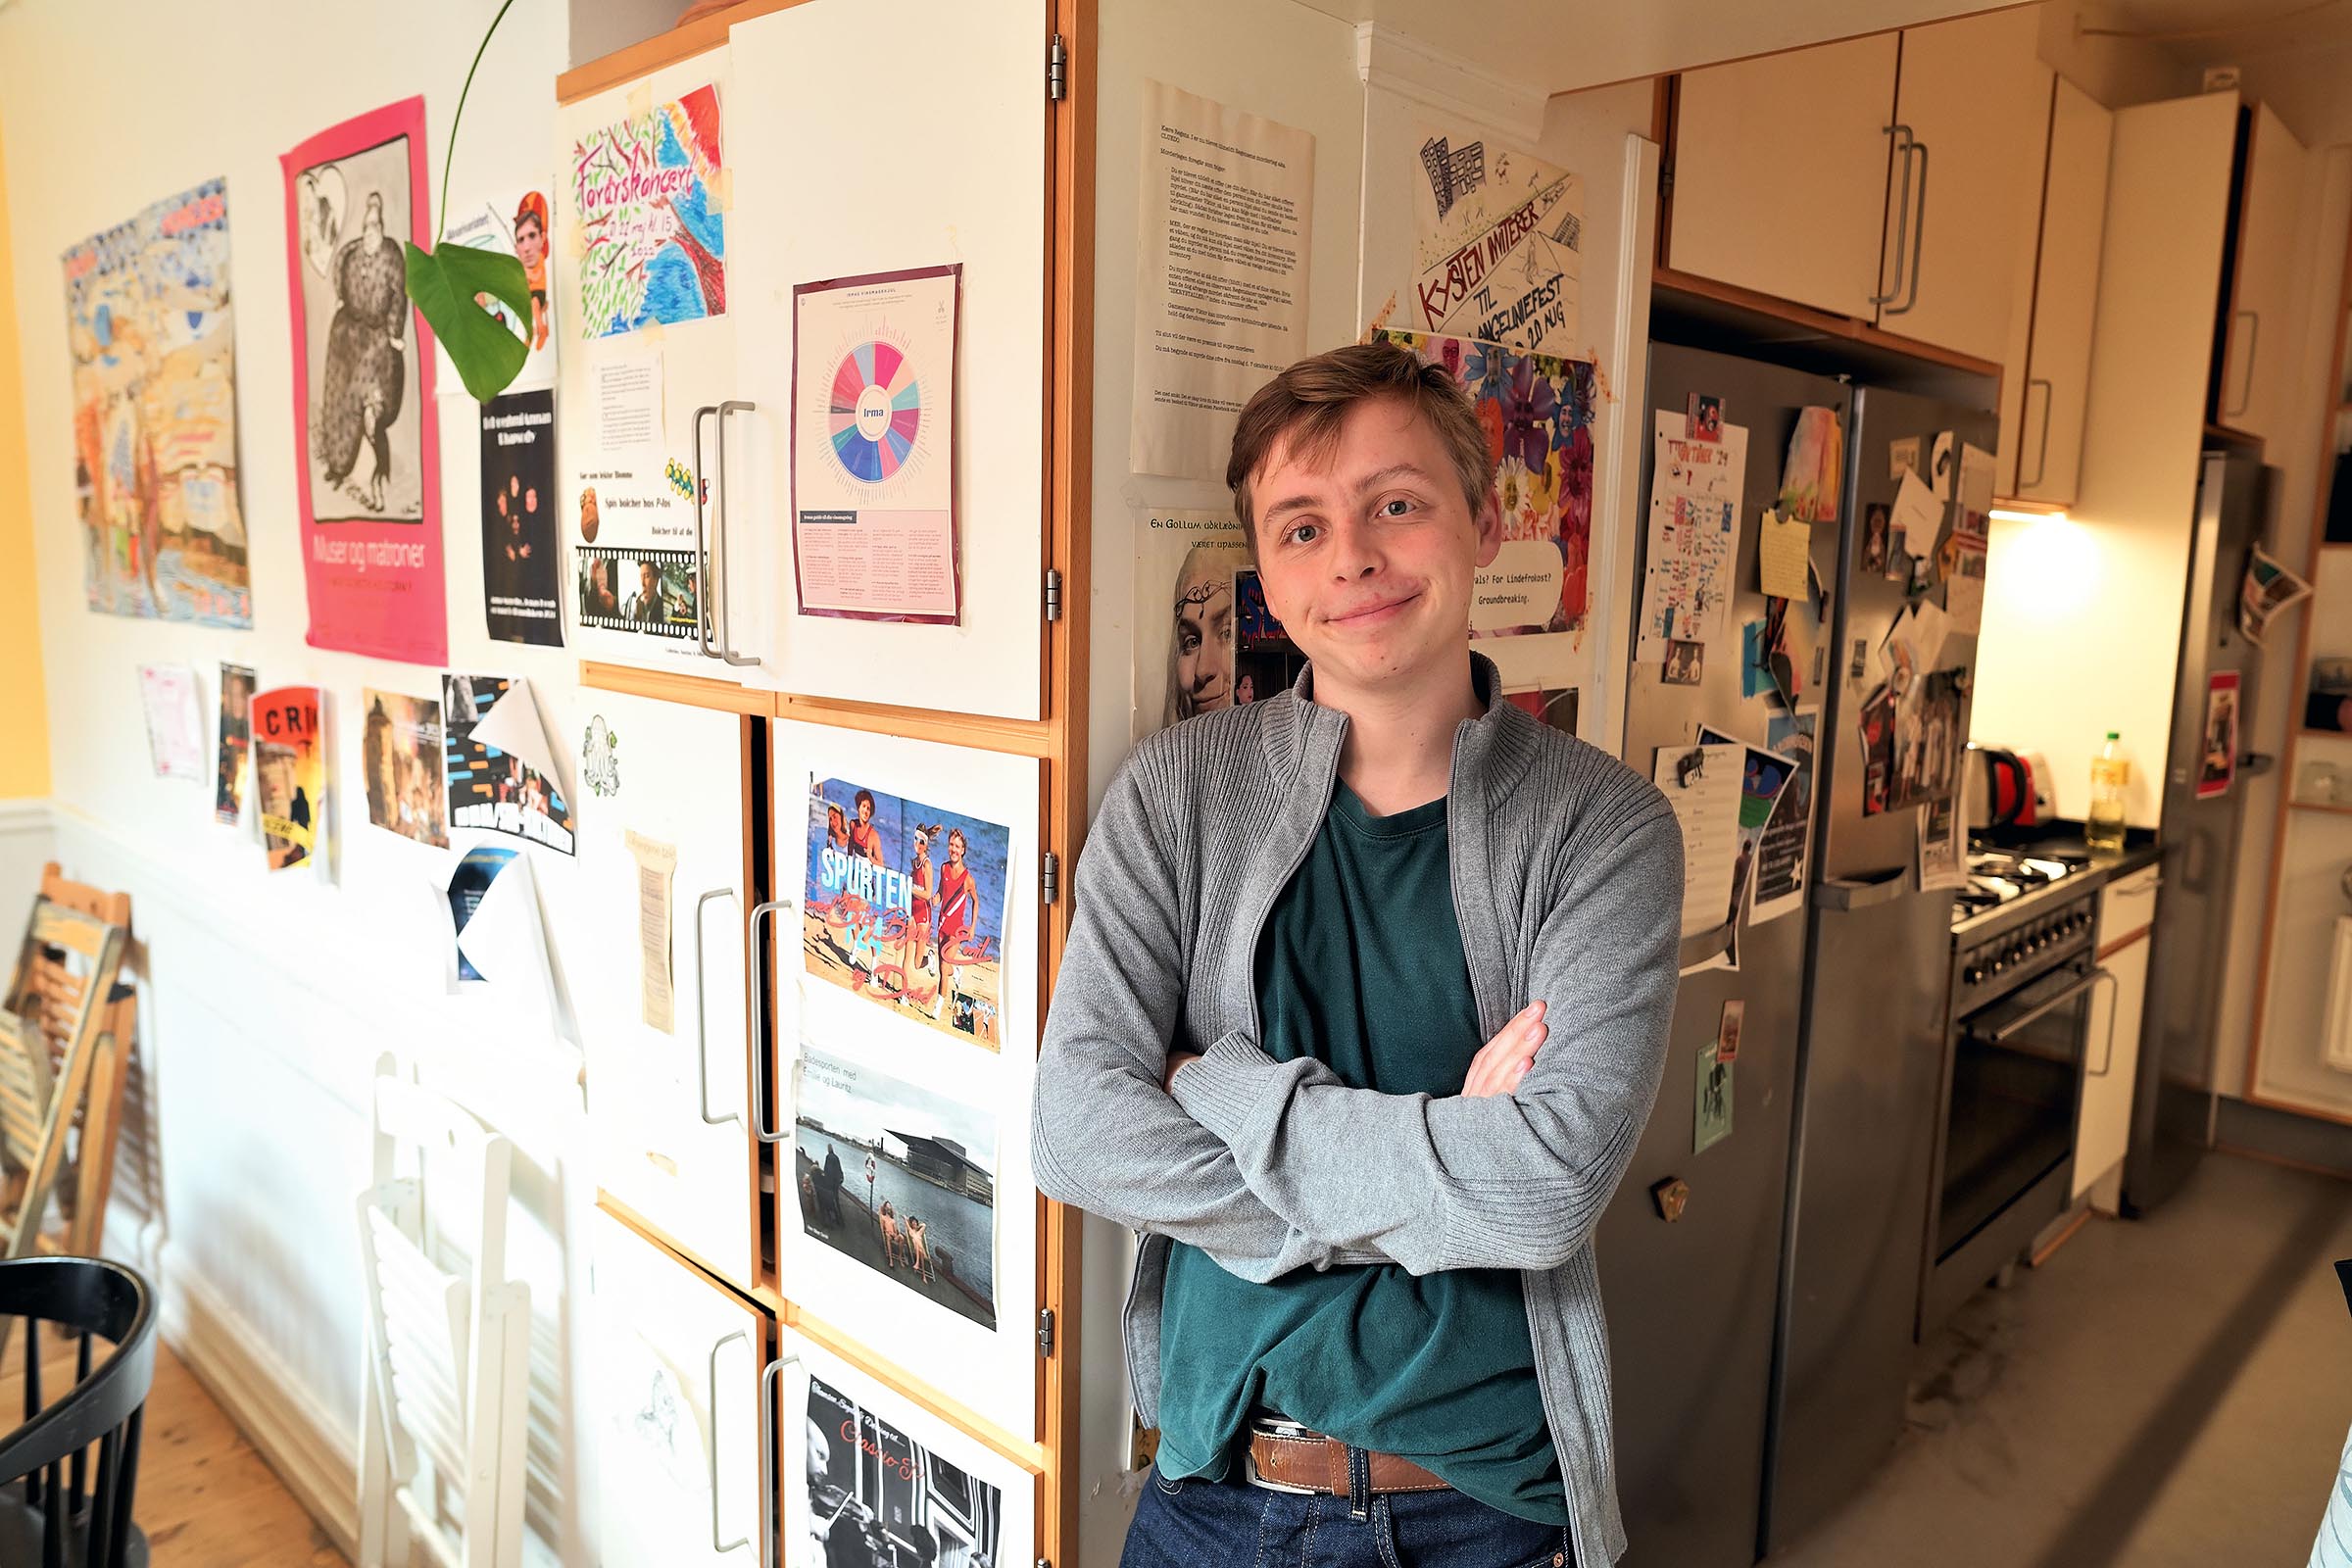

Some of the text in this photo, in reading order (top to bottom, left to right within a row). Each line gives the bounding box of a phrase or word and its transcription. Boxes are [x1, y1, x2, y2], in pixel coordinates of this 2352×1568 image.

[1417, 242, 1486, 332] KYSTEN
[1473, 285, 1497, 316] TIL
[863, 408, 884, 417] Irma
[619, 498, 639, 508] bolcher
[314, 534, 425, 572] Muser og matroner
[1492, 574, 1503, 584] For
[1506, 572, 1551, 584] Lindefrokost?
[1478, 593, 1530, 605] Groundbreaking.
[821, 848, 912, 918] SPURTEN
[941, 925, 993, 965] Emil
[844, 1069, 857, 1081] med
